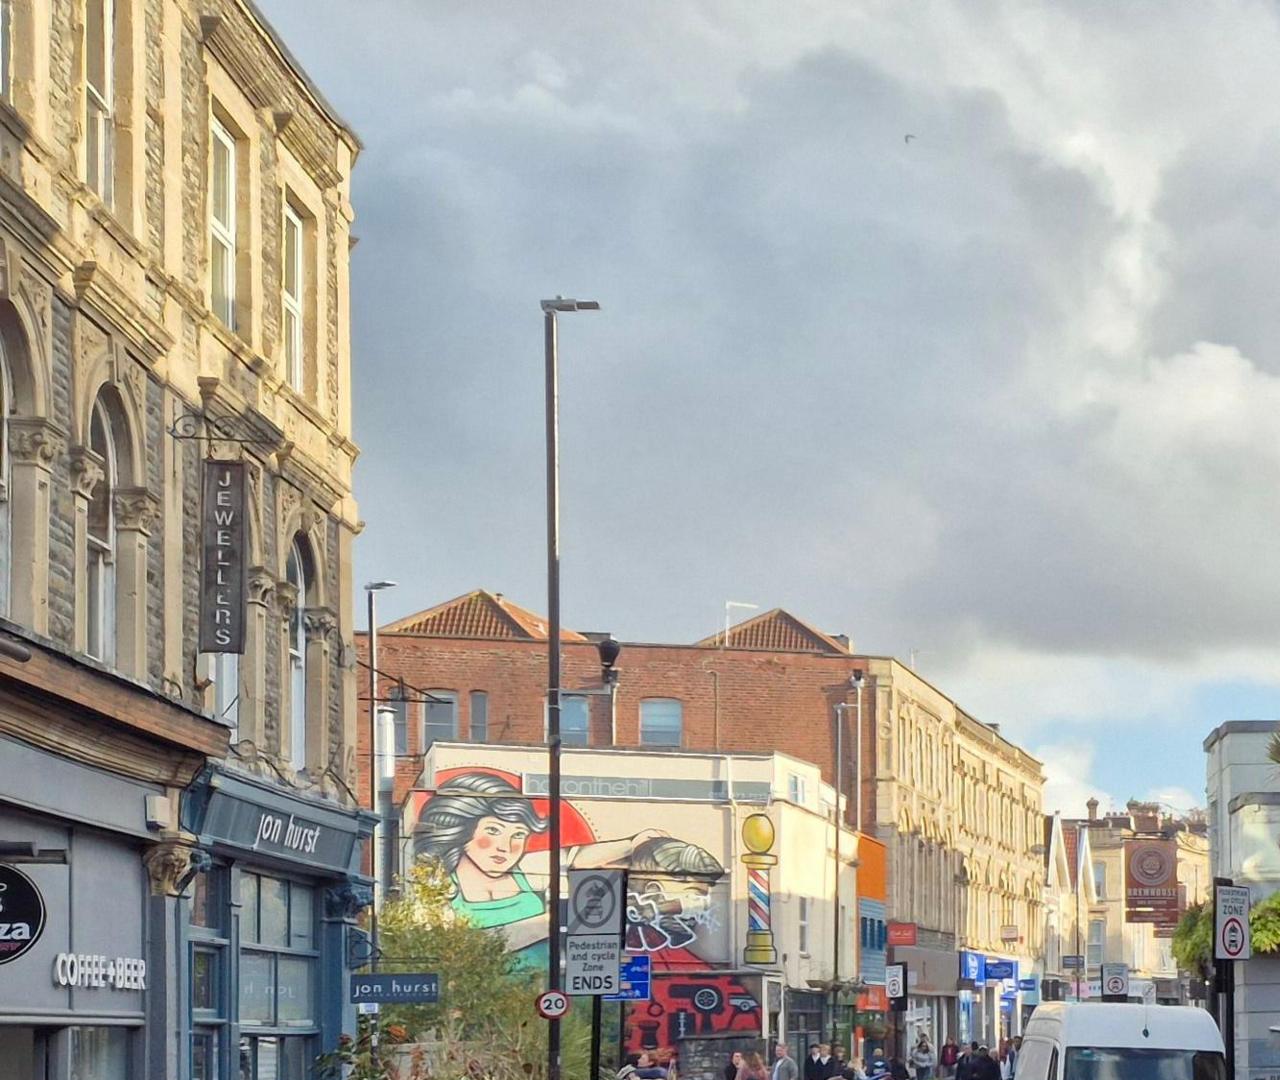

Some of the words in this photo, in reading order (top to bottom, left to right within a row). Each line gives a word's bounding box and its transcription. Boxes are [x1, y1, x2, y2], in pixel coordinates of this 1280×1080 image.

[214, 471, 234, 645] JEWELLERS
[252, 813, 281, 850] jon
[284, 814, 321, 853] hurst
[1223, 904, 1244, 916] ZONE
[569, 941, 617, 950] Pedestrian
[571, 951, 588, 961] and
[591, 951, 615, 963] cycle
[582, 963, 604, 972] Zone
[353, 984, 382, 998] jon
[391, 979, 437, 993] hurst
[572, 975, 613, 990] ENDS
[543, 998, 565, 1010] 20
